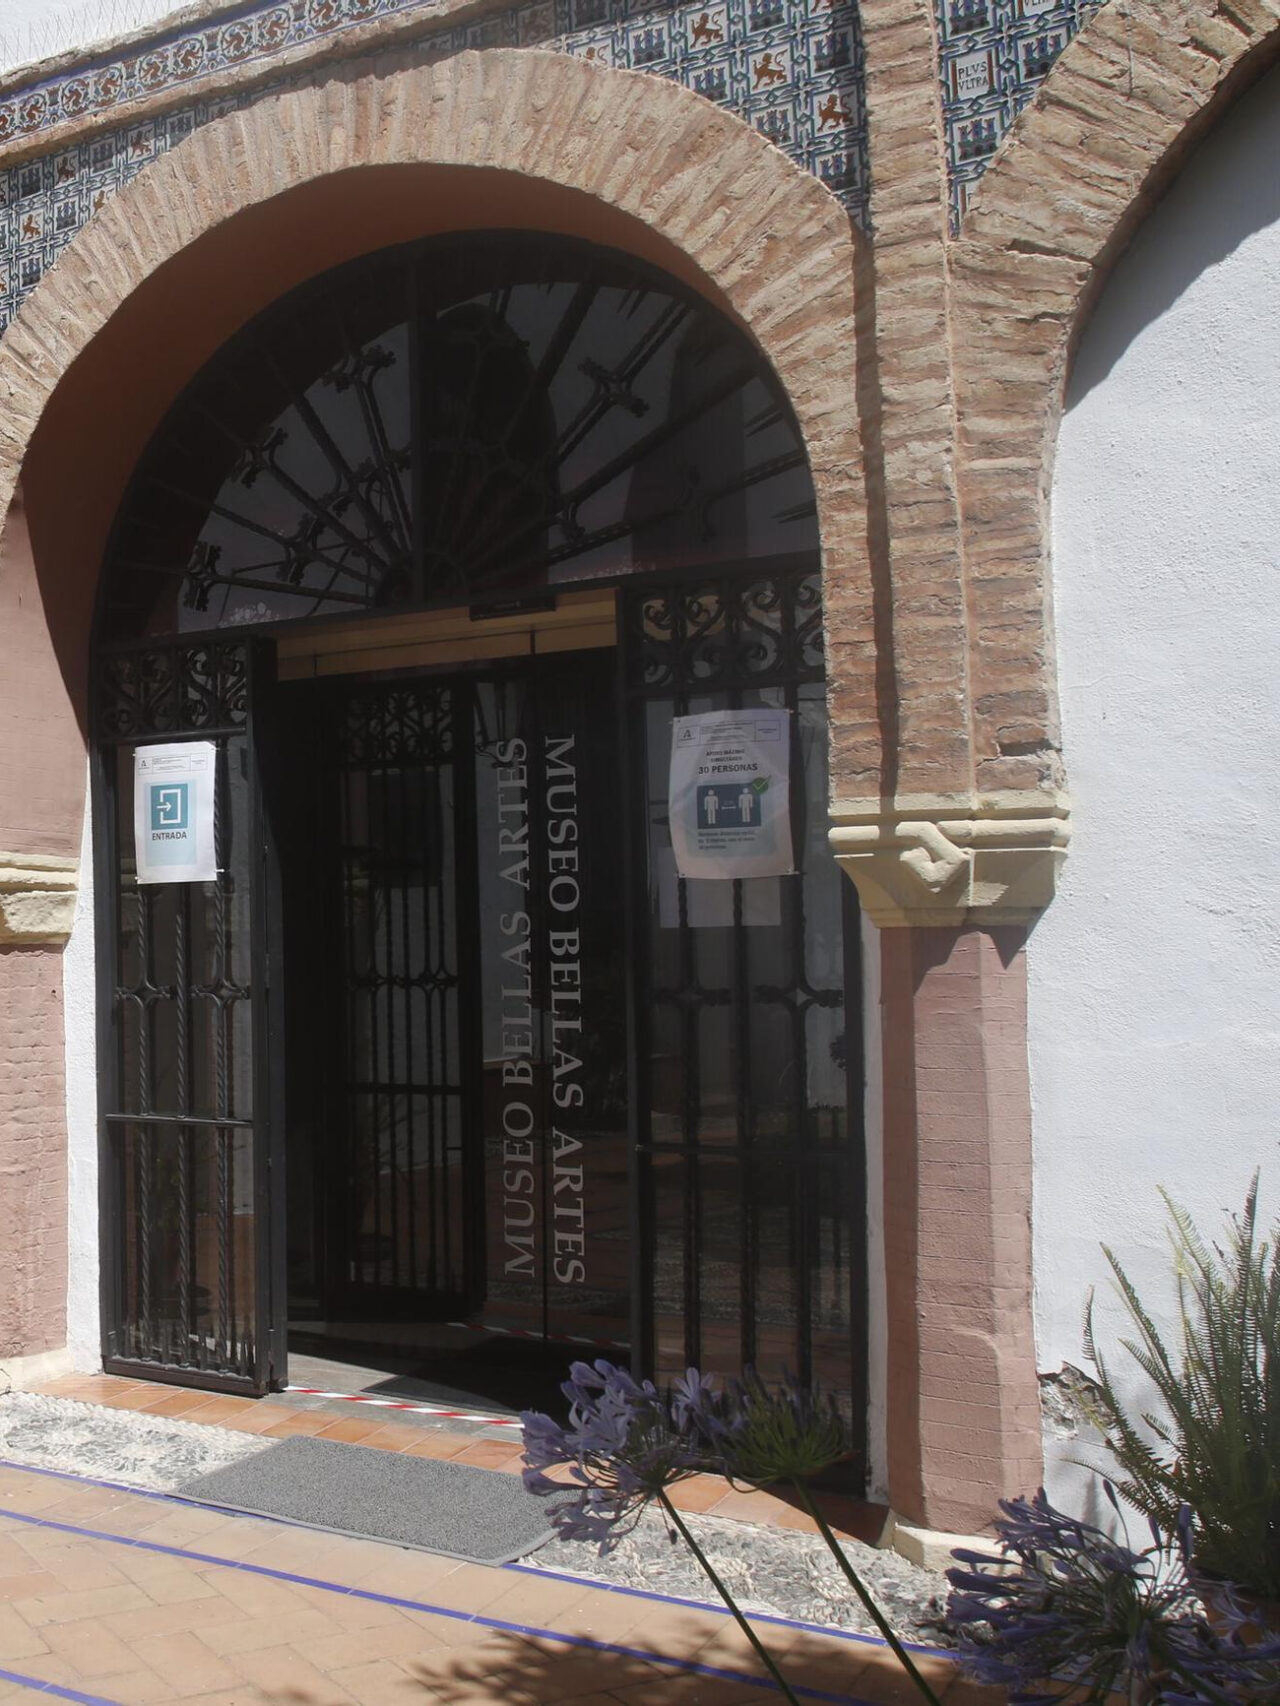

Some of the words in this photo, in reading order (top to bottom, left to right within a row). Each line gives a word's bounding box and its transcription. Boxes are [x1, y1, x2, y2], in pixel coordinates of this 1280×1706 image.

[958, 61, 988, 79] PLVS
[958, 76, 989, 91] VLTRA
[152, 831, 187, 841] ENTRADA
[496, 737, 531, 891] ARTES
[545, 734, 580, 912] MUSEO
[698, 766, 710, 774] 30
[711, 763, 758, 773] PERSONAS
[500, 911, 534, 1087] BELLAS
[549, 927, 584, 1108] BELLAS
[502, 1101, 535, 1277] MUSEO
[552, 1126, 586, 1284] ARTES
